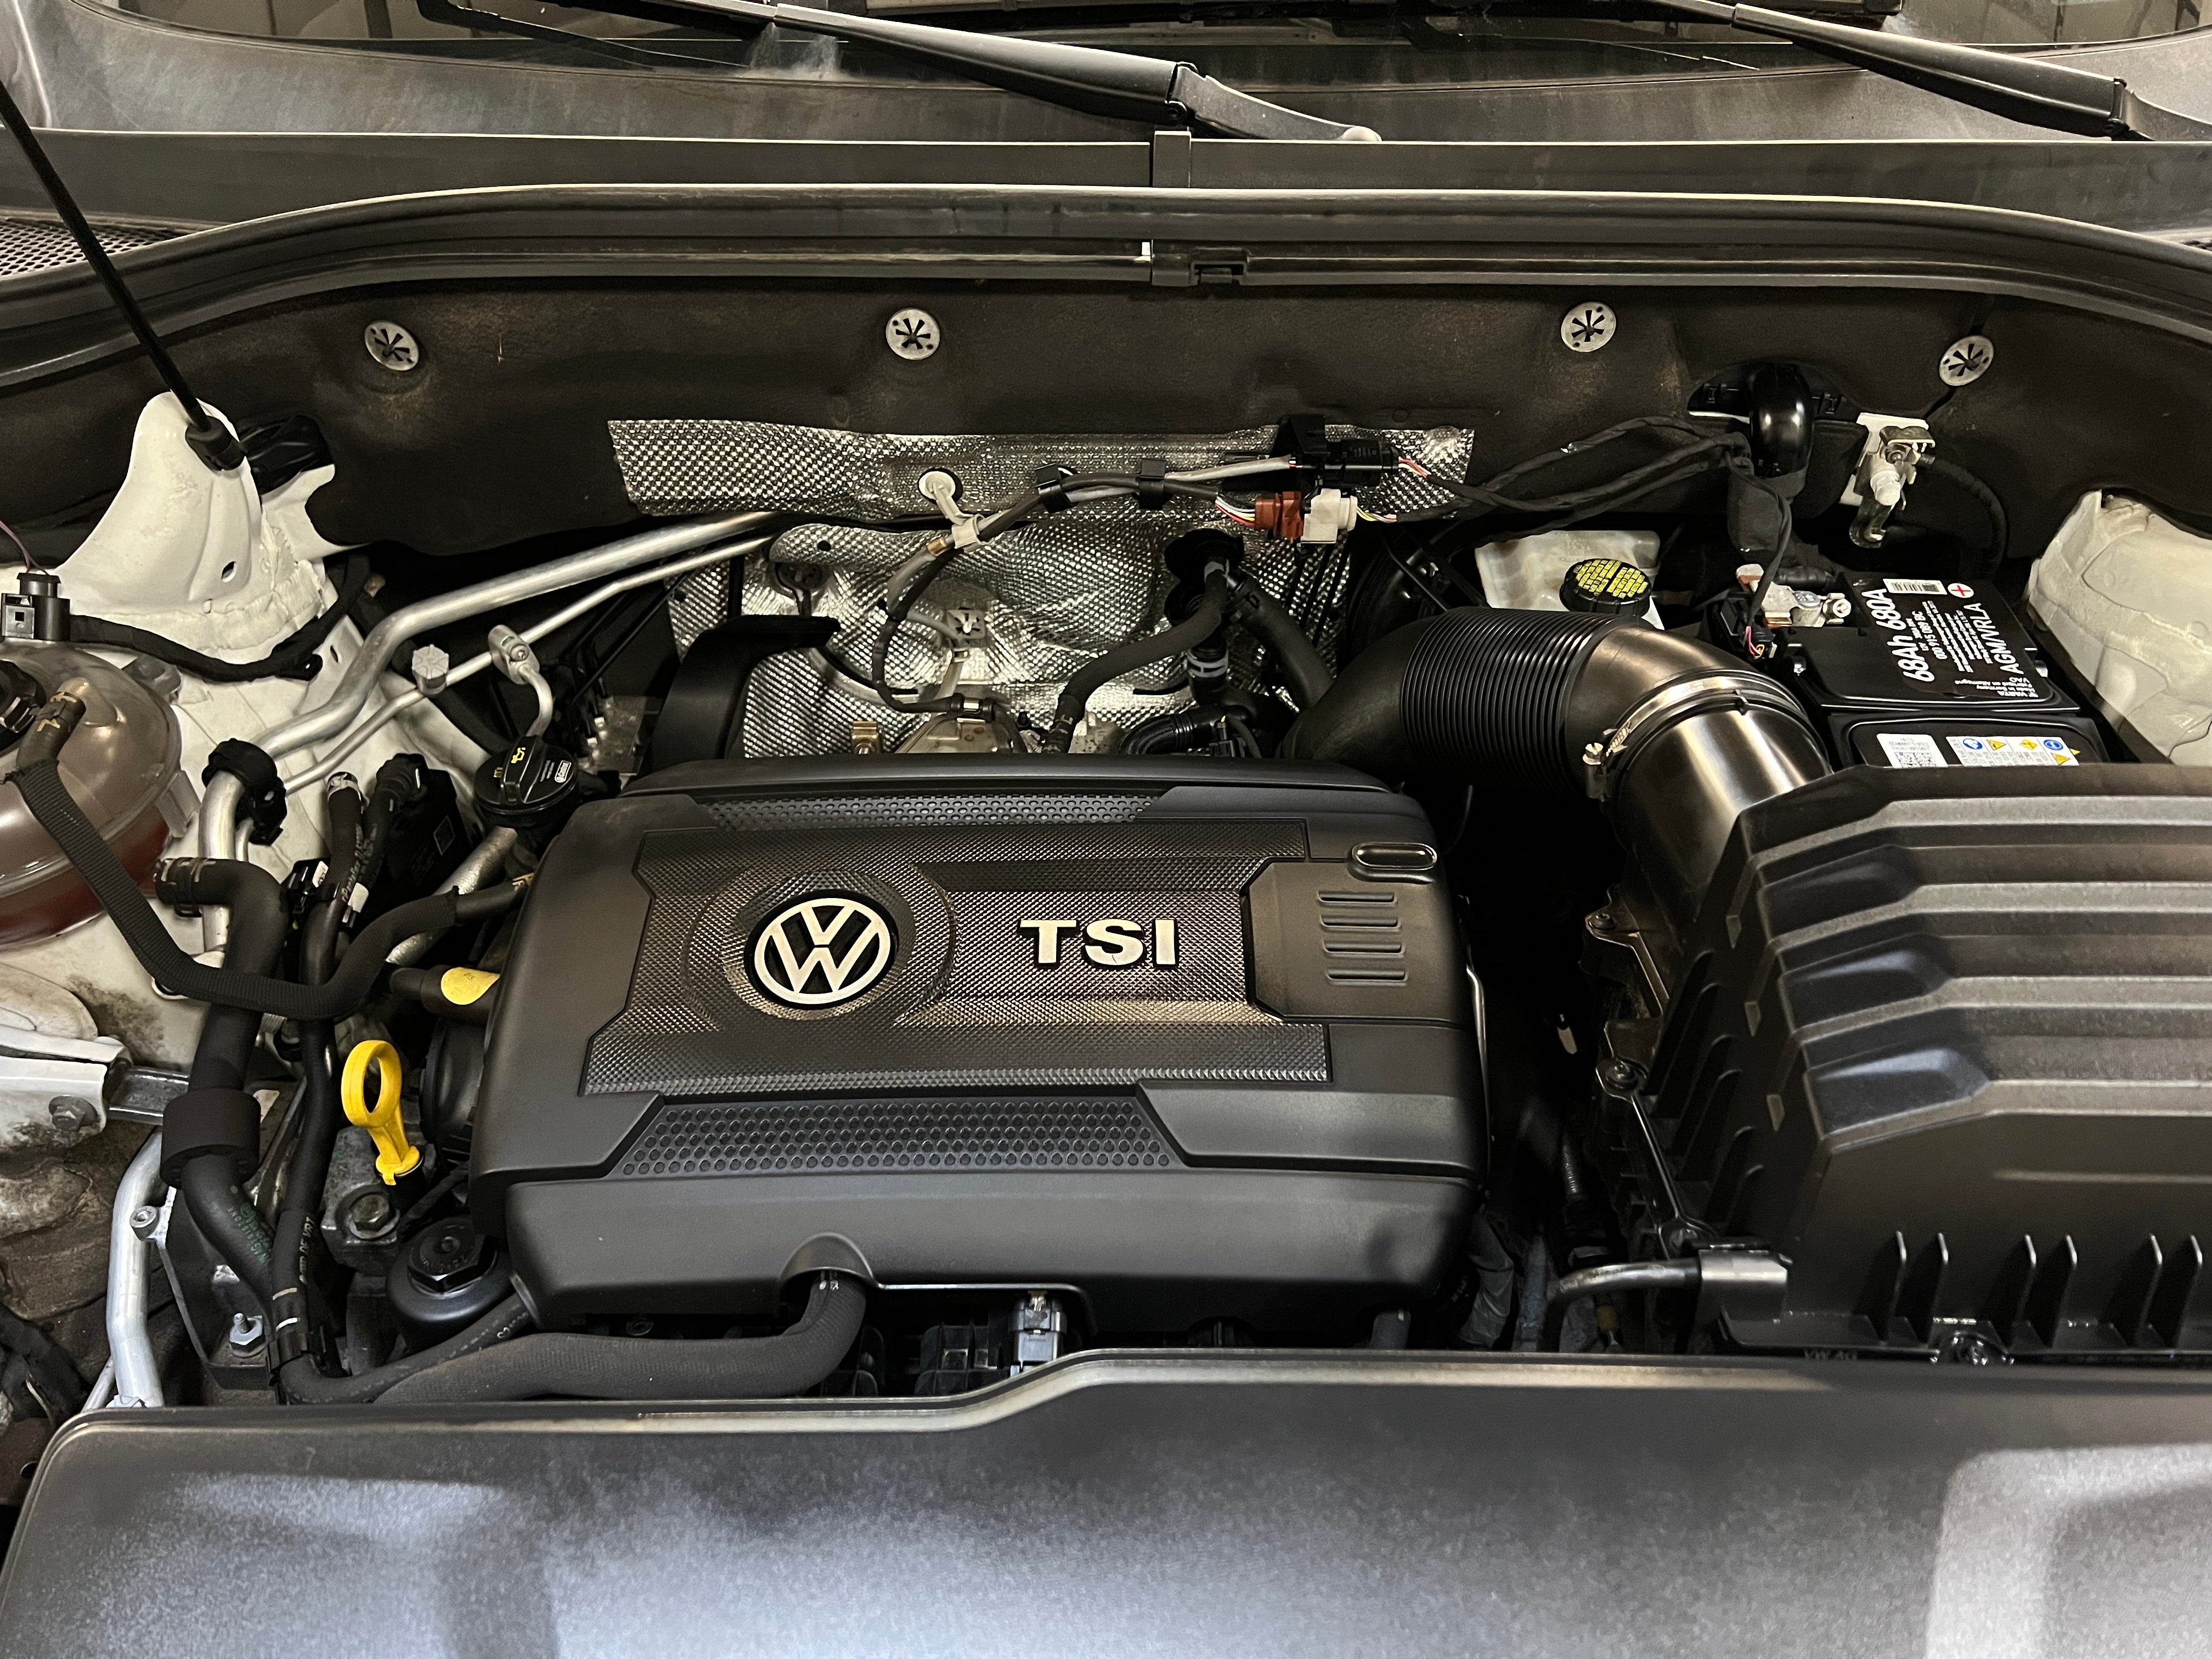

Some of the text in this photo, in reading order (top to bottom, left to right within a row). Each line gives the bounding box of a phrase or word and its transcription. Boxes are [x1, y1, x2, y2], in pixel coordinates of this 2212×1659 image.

[1861, 588, 1906, 630] 680A
[1887, 635, 1935, 682] 68Ah
[1924, 634, 1940, 647] 915
[1963, 603, 2024, 675] AGM/VRLA
[754, 898, 891, 1004] VW
[1020, 919, 1177, 966] TSI
